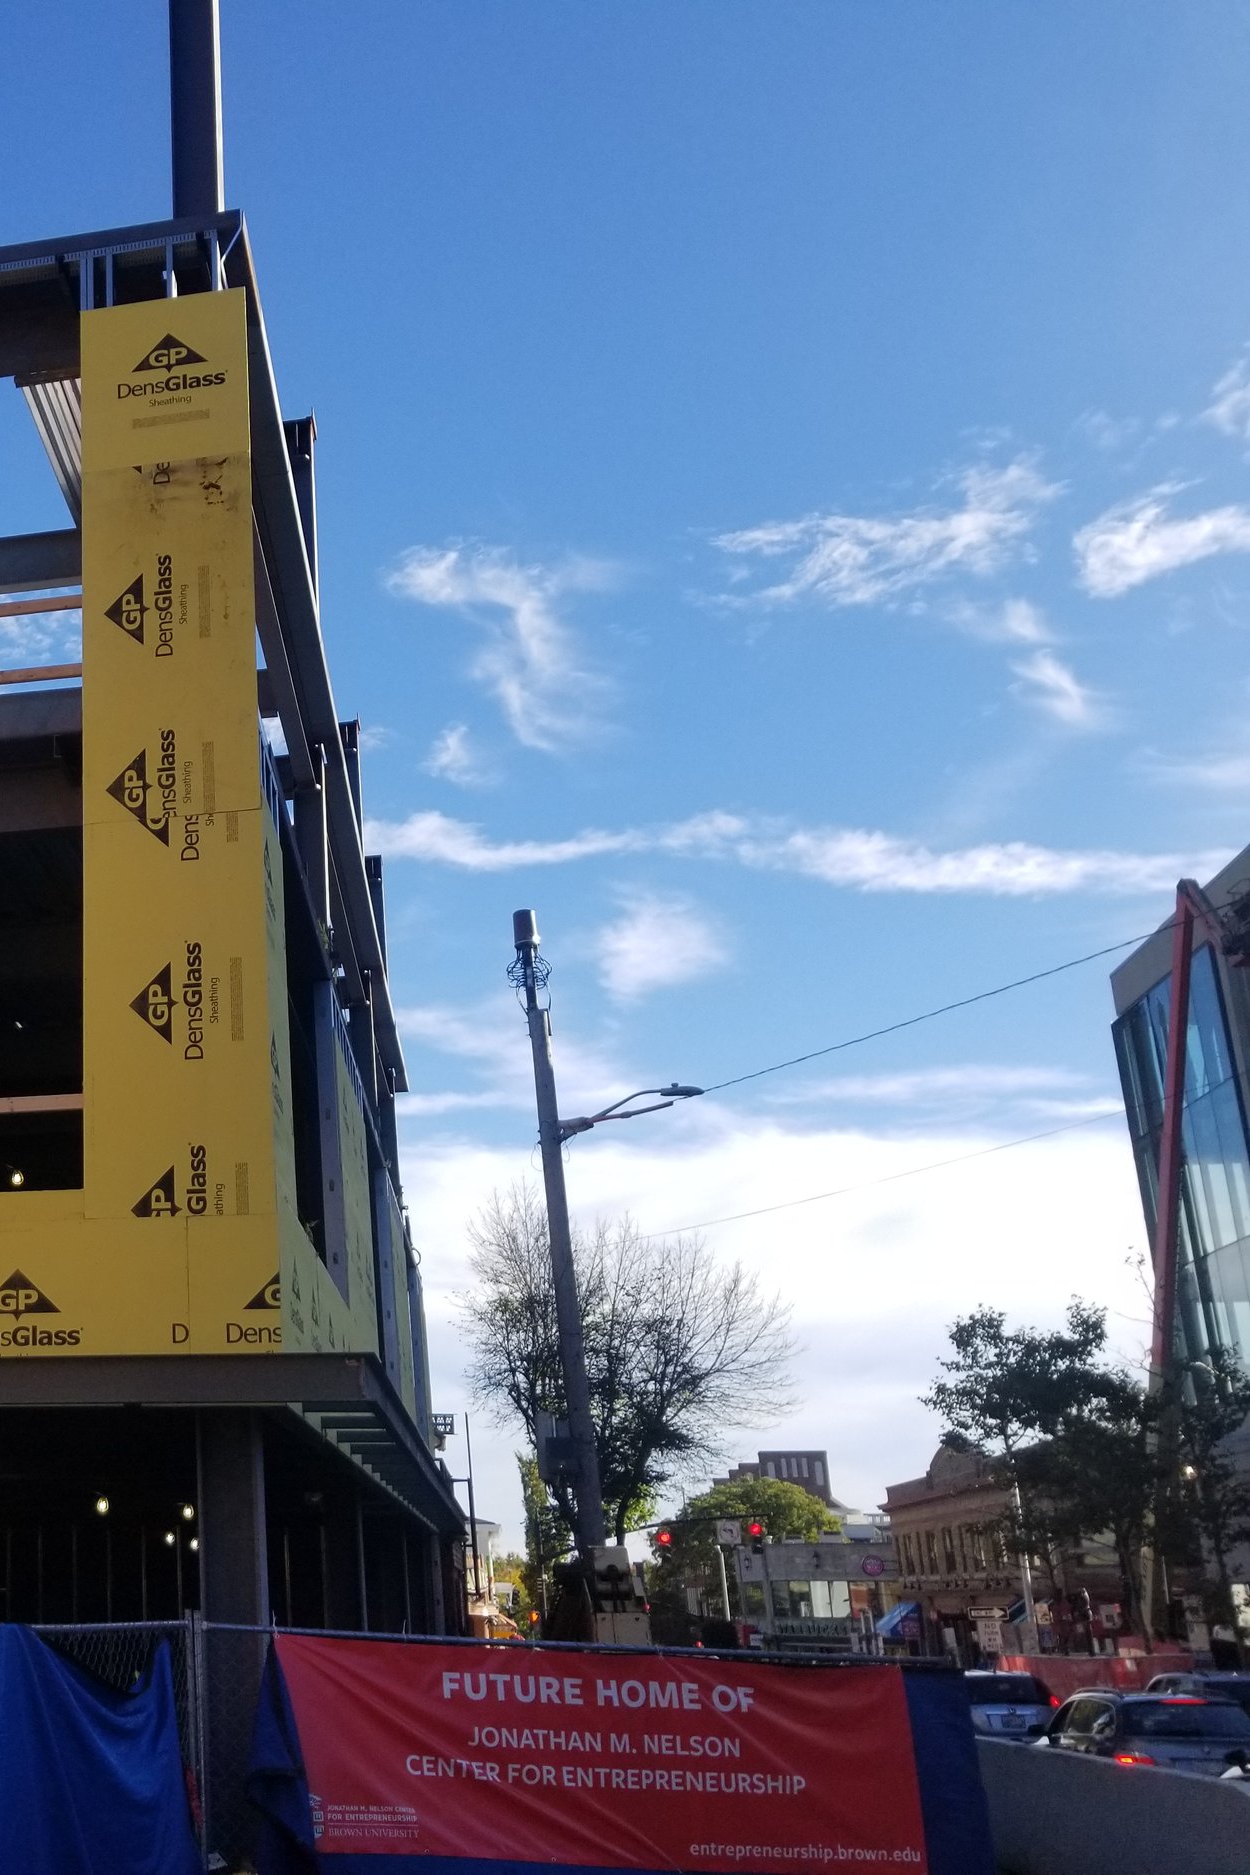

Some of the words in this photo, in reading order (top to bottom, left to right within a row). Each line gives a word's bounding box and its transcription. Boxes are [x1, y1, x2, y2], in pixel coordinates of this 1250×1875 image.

[150, 347, 188, 367] GP
[117, 371, 226, 399] DensGlass
[149, 395, 192, 408] Sheathing
[122, 593, 142, 630] GP
[154, 554, 174, 658] DensGlass
[179, 584, 189, 625] Sheathing
[124, 769, 144, 808] GP
[182, 761, 194, 804] Sheathing
[148, 983, 169, 1027] GP
[182, 941, 203, 1060] DensGlass
[210, 977, 221, 1024] Sheathing
[172, 1323, 190, 1344] D
[442, 1672, 584, 1705] FUTURE
[596, 1679, 702, 1710] HOME
[711, 1684, 755, 1713] OF
[468, 1726, 602, 1752] JONATHAN
[610, 1733, 637, 1754] M.
[644, 1734, 741, 1758] NELSON
[406, 1755, 500, 1783] CENTER
[507, 1764, 557, 1786] FOR
[562, 1766, 806, 1795] ENTREPRENEURSHIP
[327, 1804, 359, 1812] JONATHAN
[369, 1805, 393, 1813] NELSON
[327, 1813, 343, 1821] FOR
[345, 1813, 418, 1822] ENTREPRENEURSHIP
[329, 1827, 362, 1837] BROWN
[365, 1828, 420, 1839] UNIVERSITY
[690, 1842, 921, 1863] entrepreneurship.brown.edu
